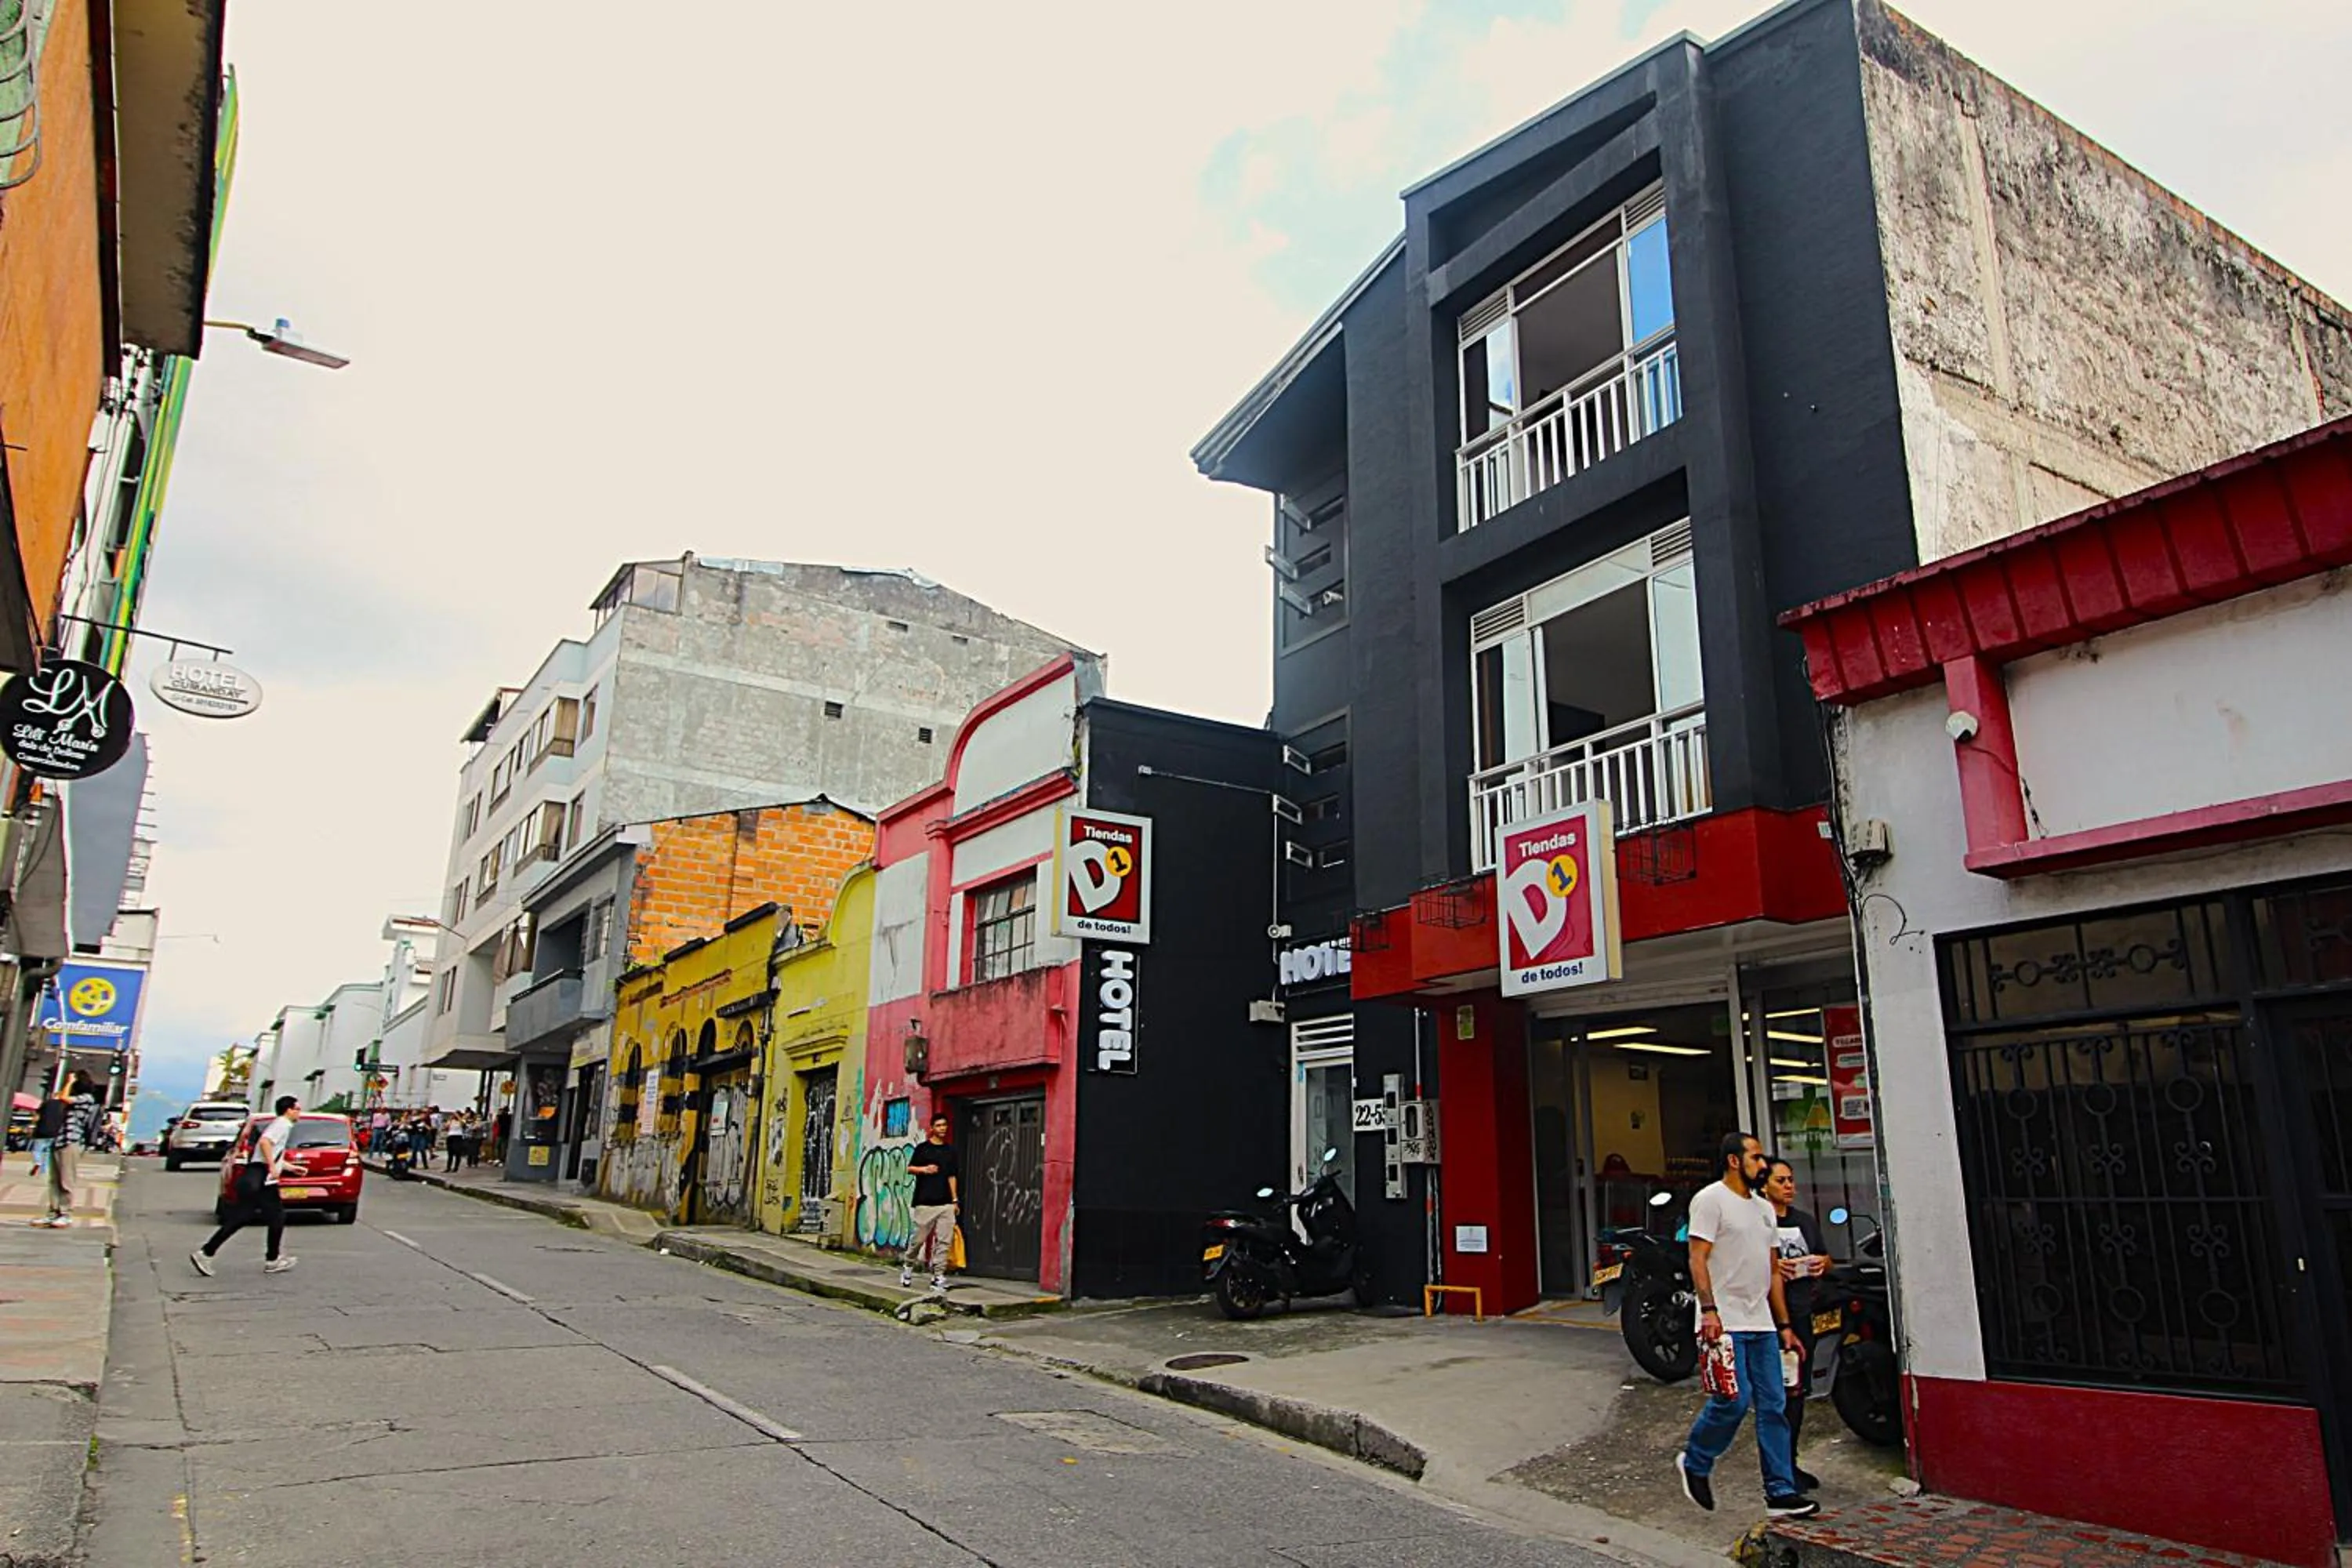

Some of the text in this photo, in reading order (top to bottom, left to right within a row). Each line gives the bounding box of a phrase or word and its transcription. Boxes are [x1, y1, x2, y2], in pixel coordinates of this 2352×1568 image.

[169, 663, 238, 688] HOTEL
[1083, 824, 1133, 844] Tiendas
[1519, 831, 1576, 858] Tiendas
[1077, 919, 1132, 935] de todos!
[1279, 942, 1352, 985] HOTE
[1521, 962, 1584, 983] de todos!
[1098, 949, 1134, 1071] HOTEL
[1355, 1104, 1385, 1127] 22-5
